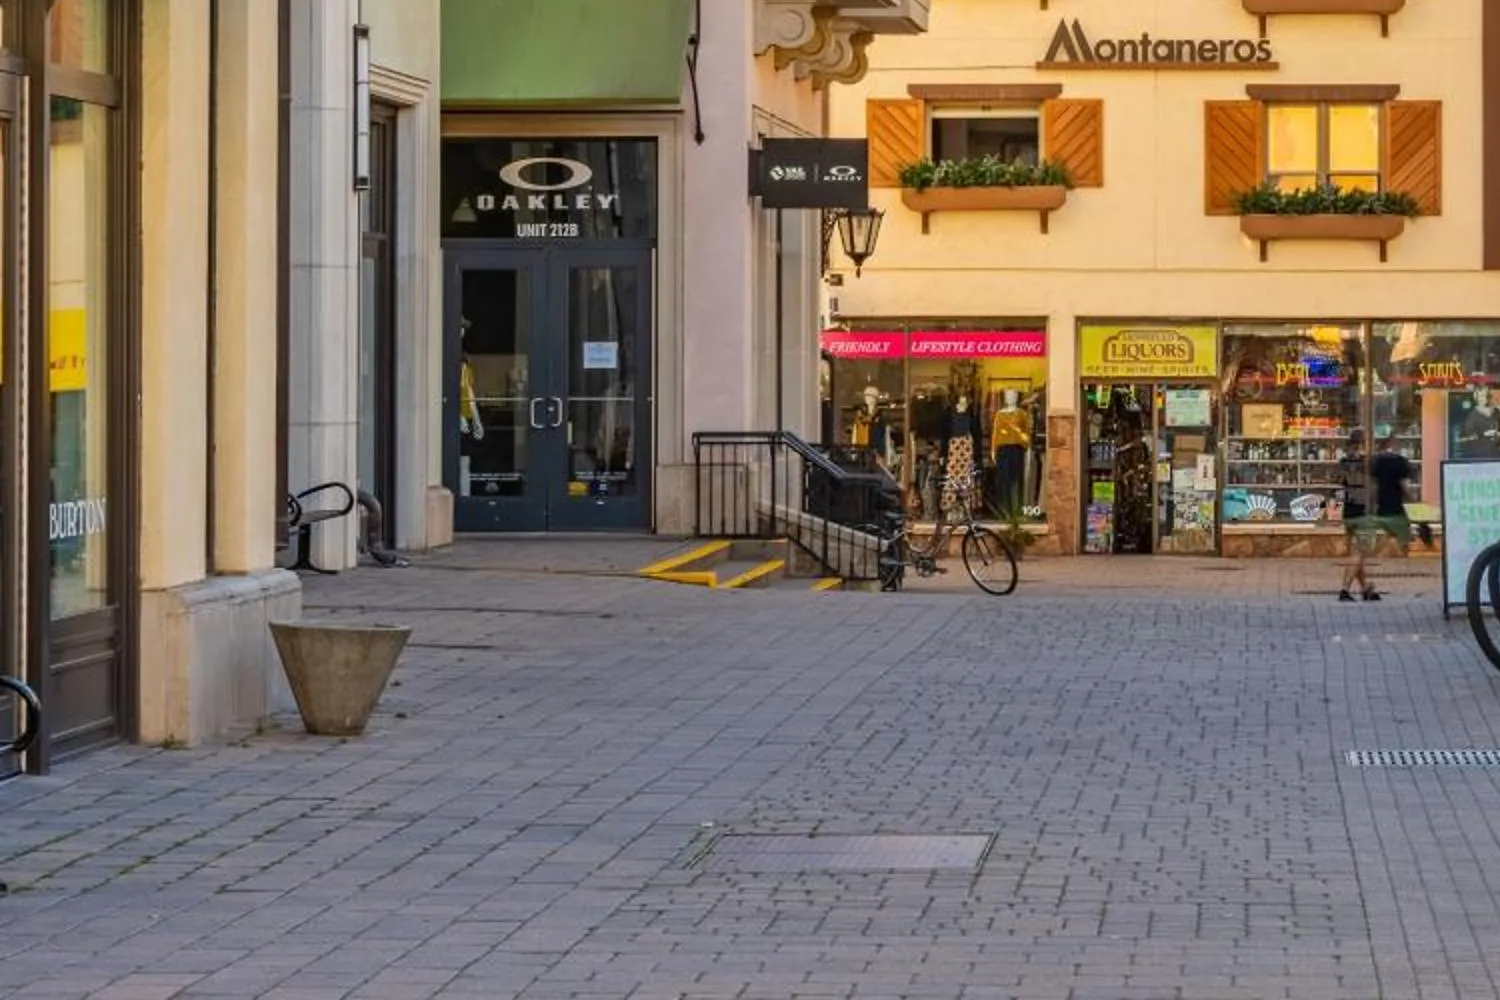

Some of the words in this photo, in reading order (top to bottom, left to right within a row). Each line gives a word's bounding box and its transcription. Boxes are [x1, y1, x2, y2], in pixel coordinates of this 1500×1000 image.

[1044, 17, 1273, 63] Montaneros
[477, 194, 614, 210] OAKLEY
[517, 223, 546, 237] UNIT
[549, 223, 579, 237] 212B
[829, 341, 891, 354] FRIENDLY
[911, 341, 974, 353] LIFESTYLE
[977, 341, 1041, 353] CLOTHING
[1111, 343, 1186, 361] LIQUORS
[49, 499, 106, 540] BURTON
